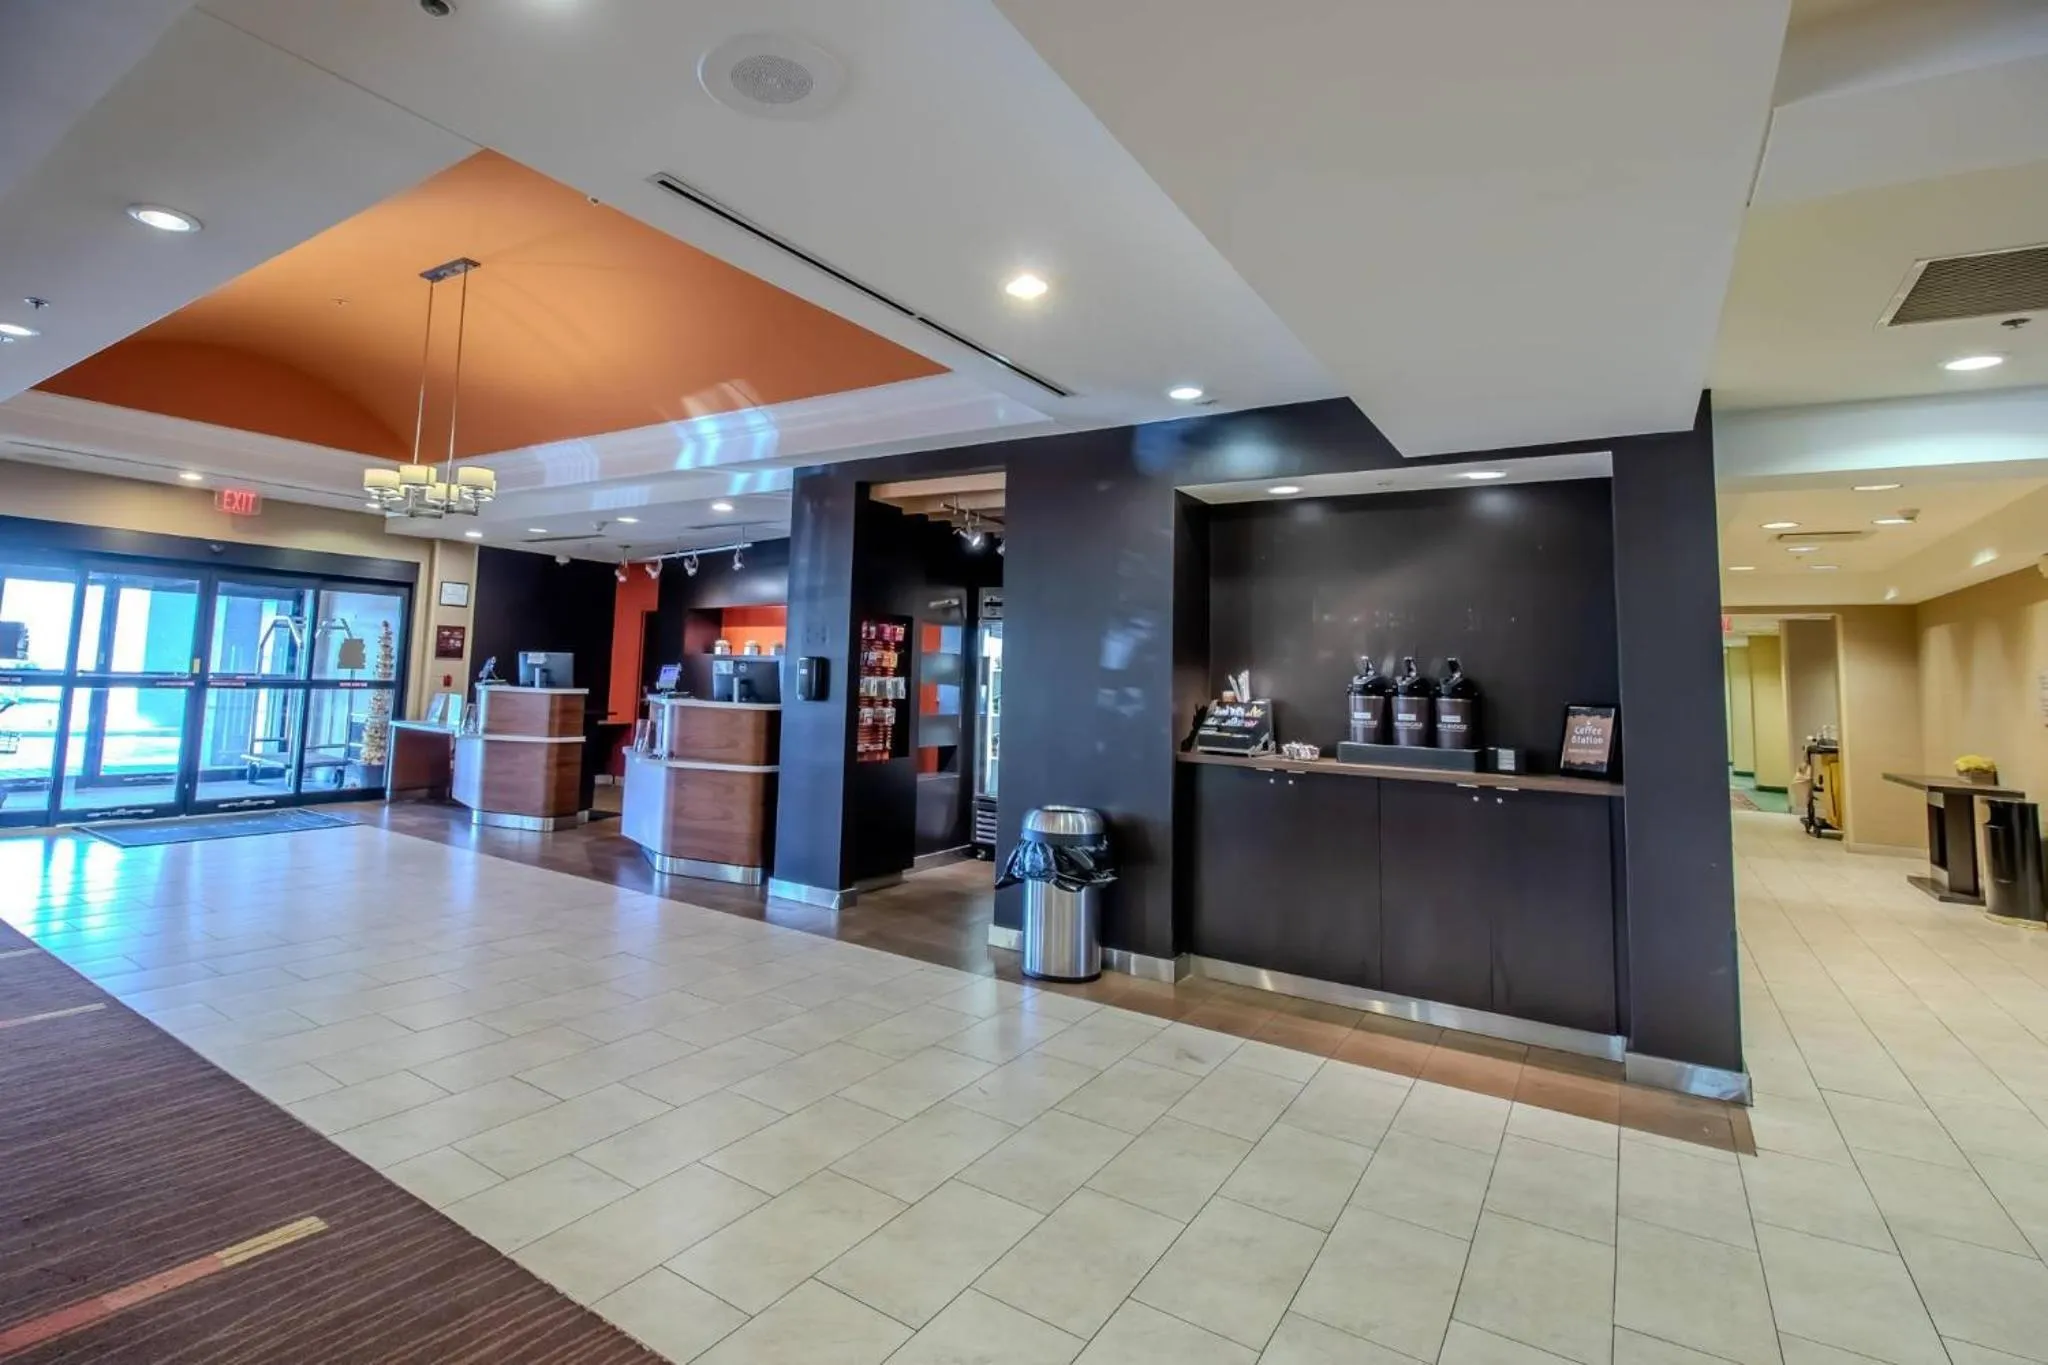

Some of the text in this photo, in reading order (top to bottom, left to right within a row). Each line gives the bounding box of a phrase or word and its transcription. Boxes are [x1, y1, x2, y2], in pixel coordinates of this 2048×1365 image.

[223, 490, 256, 512] EXIT
[1574, 725, 1602, 735] Coffee
[1571, 735, 1603, 744] Station
